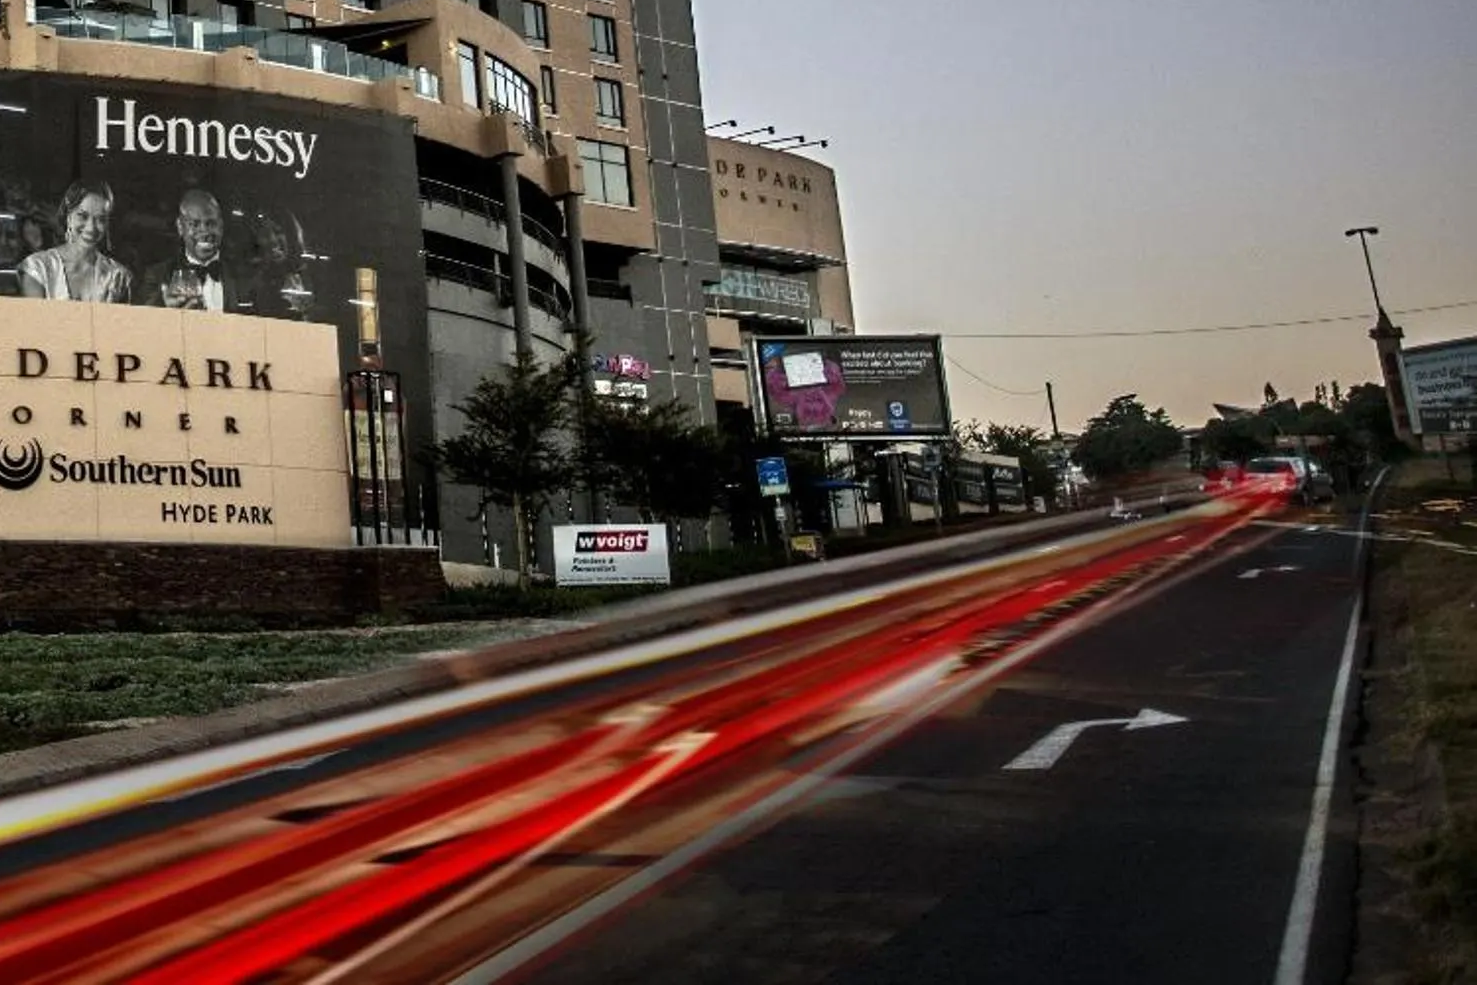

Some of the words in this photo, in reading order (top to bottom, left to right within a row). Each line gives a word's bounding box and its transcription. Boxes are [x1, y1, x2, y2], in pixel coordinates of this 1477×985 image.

[94, 97, 317, 179] Hennessy
[719, 187, 799, 212] ORNER
[161, 502, 218, 524] HYDE
[226, 503, 274, 525] PARK
